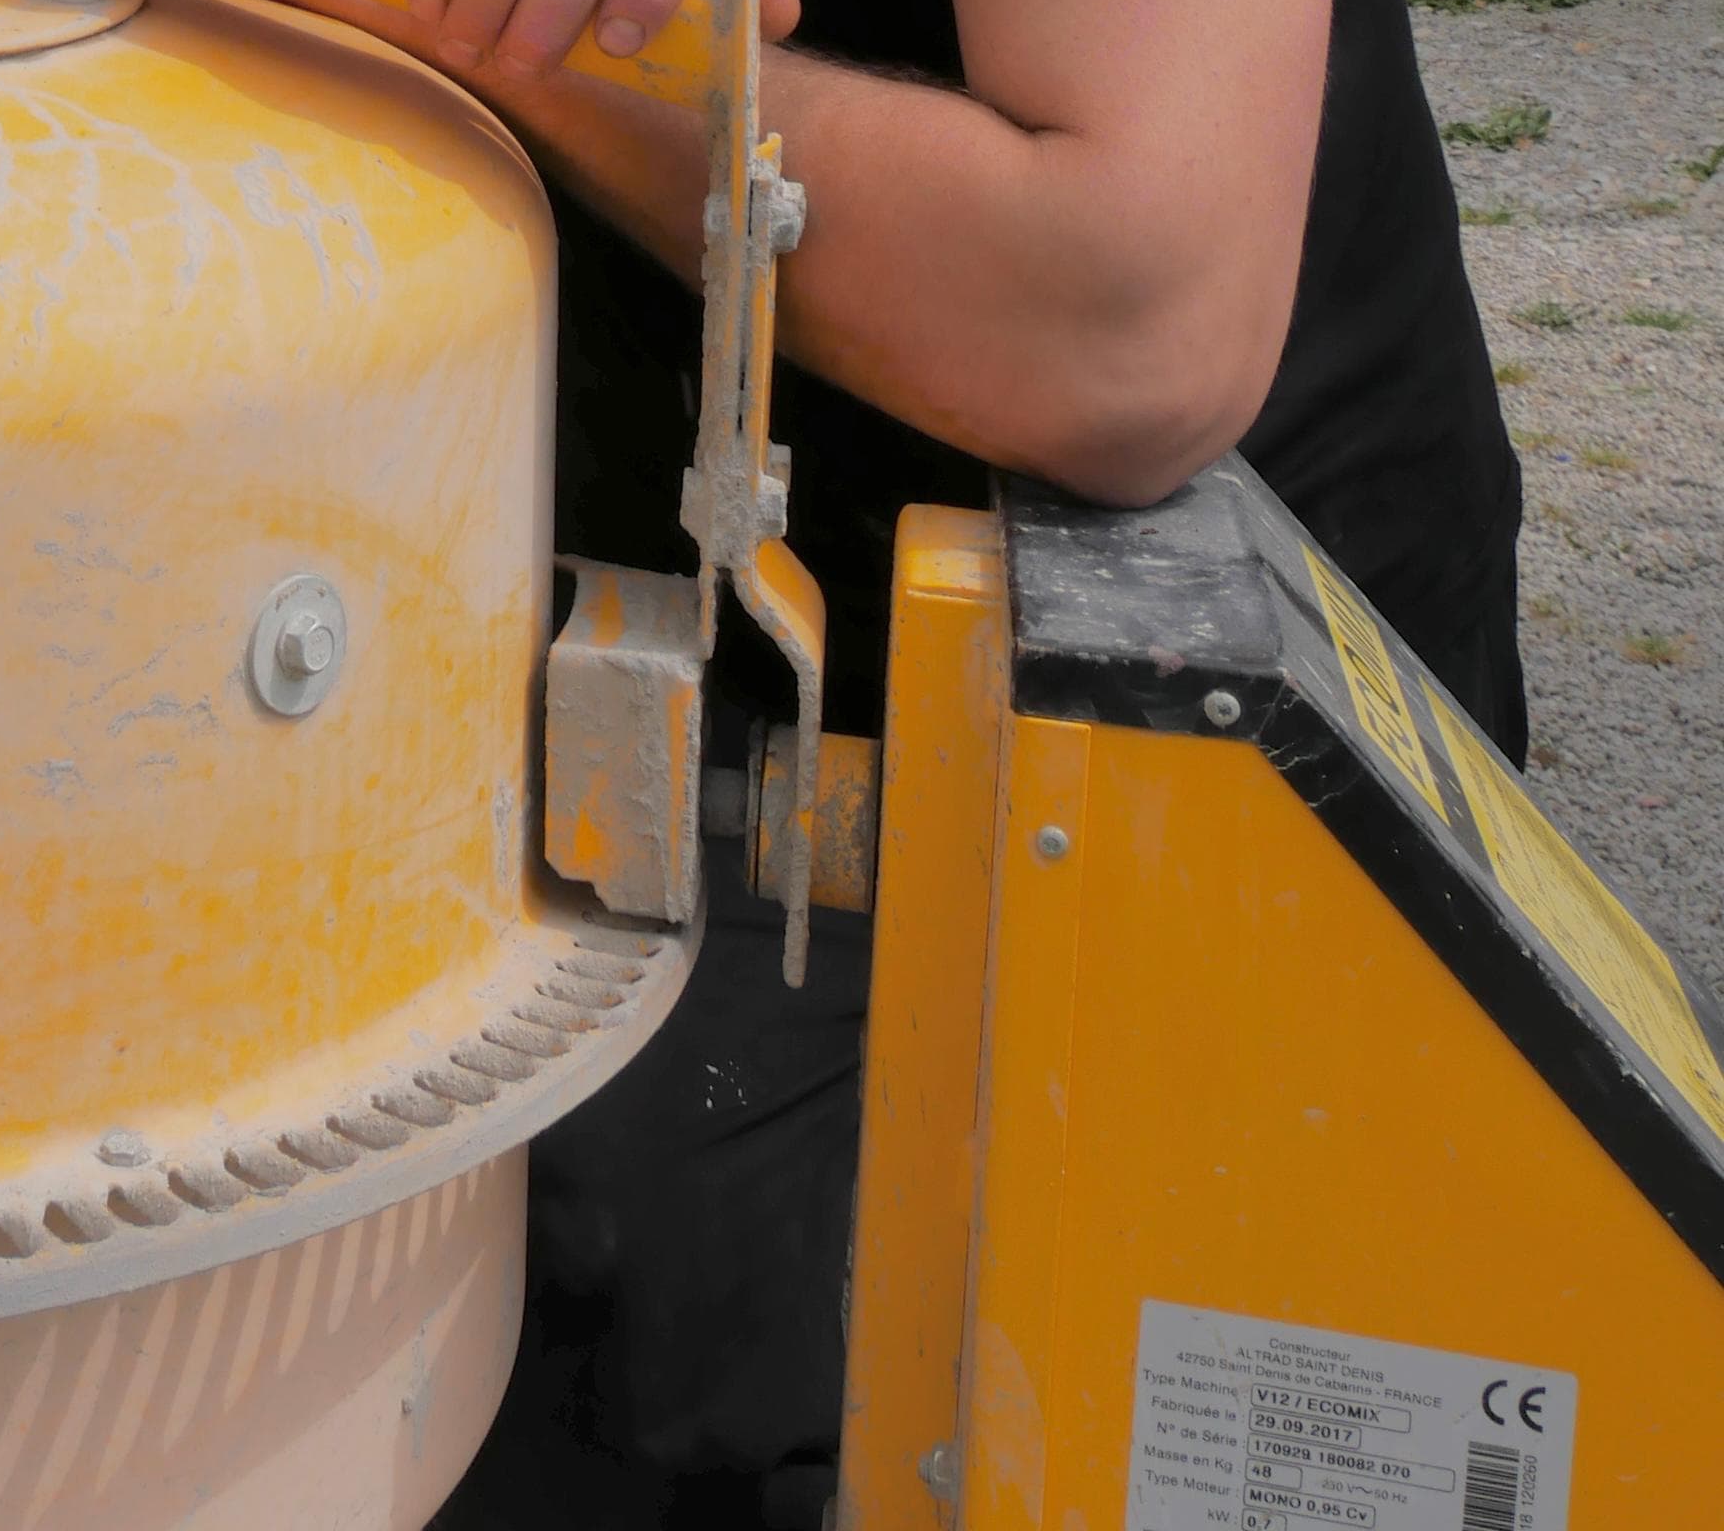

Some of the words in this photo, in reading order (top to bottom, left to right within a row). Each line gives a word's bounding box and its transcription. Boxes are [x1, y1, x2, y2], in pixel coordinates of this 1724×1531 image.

[1235, 1346, 1292, 1367] ALTRAD
[1295, 1356, 1337, 1374] SAINT
[1340, 1365, 1385, 1383] DENIS
[1268, 1337, 1351, 1362] Constructeur
[1142, 1368, 1176, 1386] Type
[1256, 1388, 1290, 1407] V12
[1307, 1397, 1381, 1423] ECOMIX
[1175, 1350, 1217, 1368] 42750
[1219, 1358, 1251, 1375] Saint
[1254, 1364, 1291, 1382] Denis
[1294, 1373, 1311, 1385] de
[1384, 1388, 1442, 1409] FRANCE
[1150, 1395, 1221, 1419] Fabriquée
[1254, 1413, 1354, 1442] 29.09.2017
[1143, 1443, 1189, 1463] Masse
[1192, 1455, 1210, 1467] en
[1214, 1458, 1234, 1475] Kg
[1180, 1426, 1198, 1439] de
[1201, 1429, 1238, 1447] Série
[1319, 1451, 1375, 1472] 180082
[1381, 1463, 1411, 1479] 070
[1144, 1468, 1179, 1487] Type
[1182, 1476, 1230, 1497] Moteur
[1249, 1488, 1302, 1510] MONO
